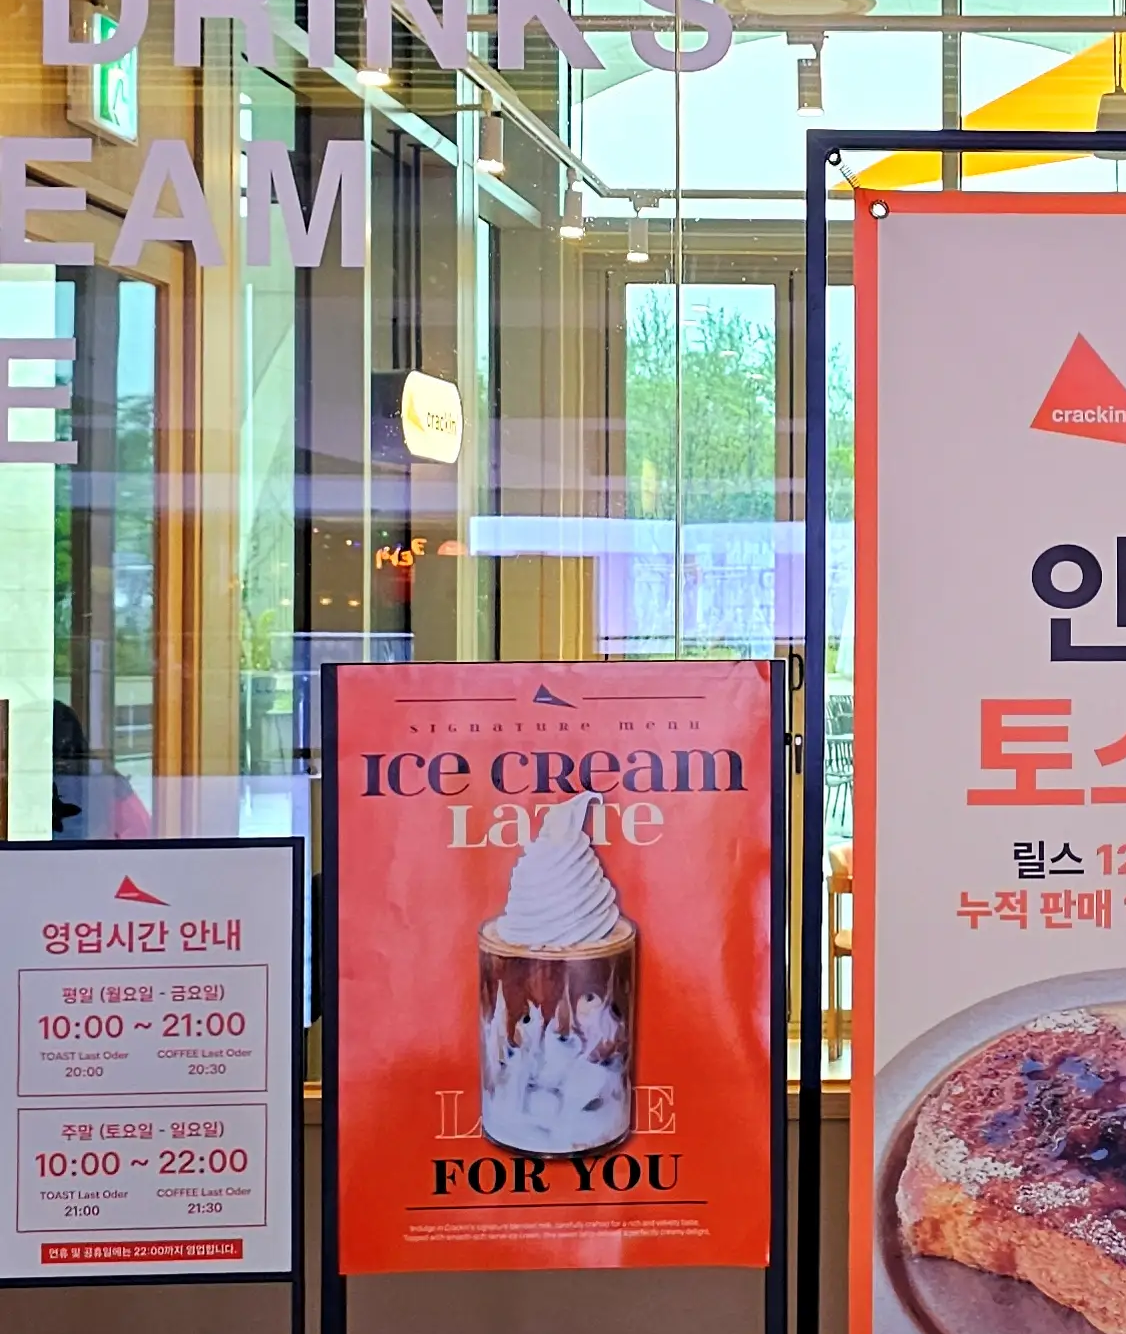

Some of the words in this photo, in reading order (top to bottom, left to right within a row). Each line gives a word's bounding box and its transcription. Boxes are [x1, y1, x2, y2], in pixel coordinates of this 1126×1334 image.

[0, 137, 366, 268] EAM
[1012, 840, 1086, 880] 릴스
[956, 891, 1028, 930] 누적
[1039, 890, 1112, 930] 판매
[42, 920, 169, 955] 영업시간
[180, 918, 241, 951] 안내
[62, 987, 94, 1004] 평일
[100, 984, 153, 1003] (월요일
[170, 984, 225, 1003] 금요일)
[38, 1014, 124, 1040] 10:00
[134, 1021, 153, 1031] ~
[162, 1012, 246, 1037] 21:00
[40, 1051, 76, 1061] TOAST
[78, 1051, 101, 1061] Last
[157, 1049, 199, 1059] COFFEE
[201, 1048, 224, 1058] Last
[65, 1066, 103, 1078] 20:00
[188, 1064, 226, 1075] 20:30
[61, 1124, 94, 1141] 주말
[100, 1123, 153, 1140] (토요일
[170, 1121, 225, 1139] 일요일)
[35, 1151, 121, 1178] 10:00
[130, 1159, 149, 1168] ~
[158, 1148, 248, 1175] 22:00
[431, 1157, 550, 1195] FOR
[571, 1154, 683, 1192] YOU
[40, 1190, 75, 1200] TOAST
[78, 1190, 100, 1199] Last
[156, 1188, 198, 1198] COFFEE
[201, 1187, 223, 1197] Last
[64, 1205, 100, 1217] 21:00
[187, 1203, 223, 1214] 21:30
